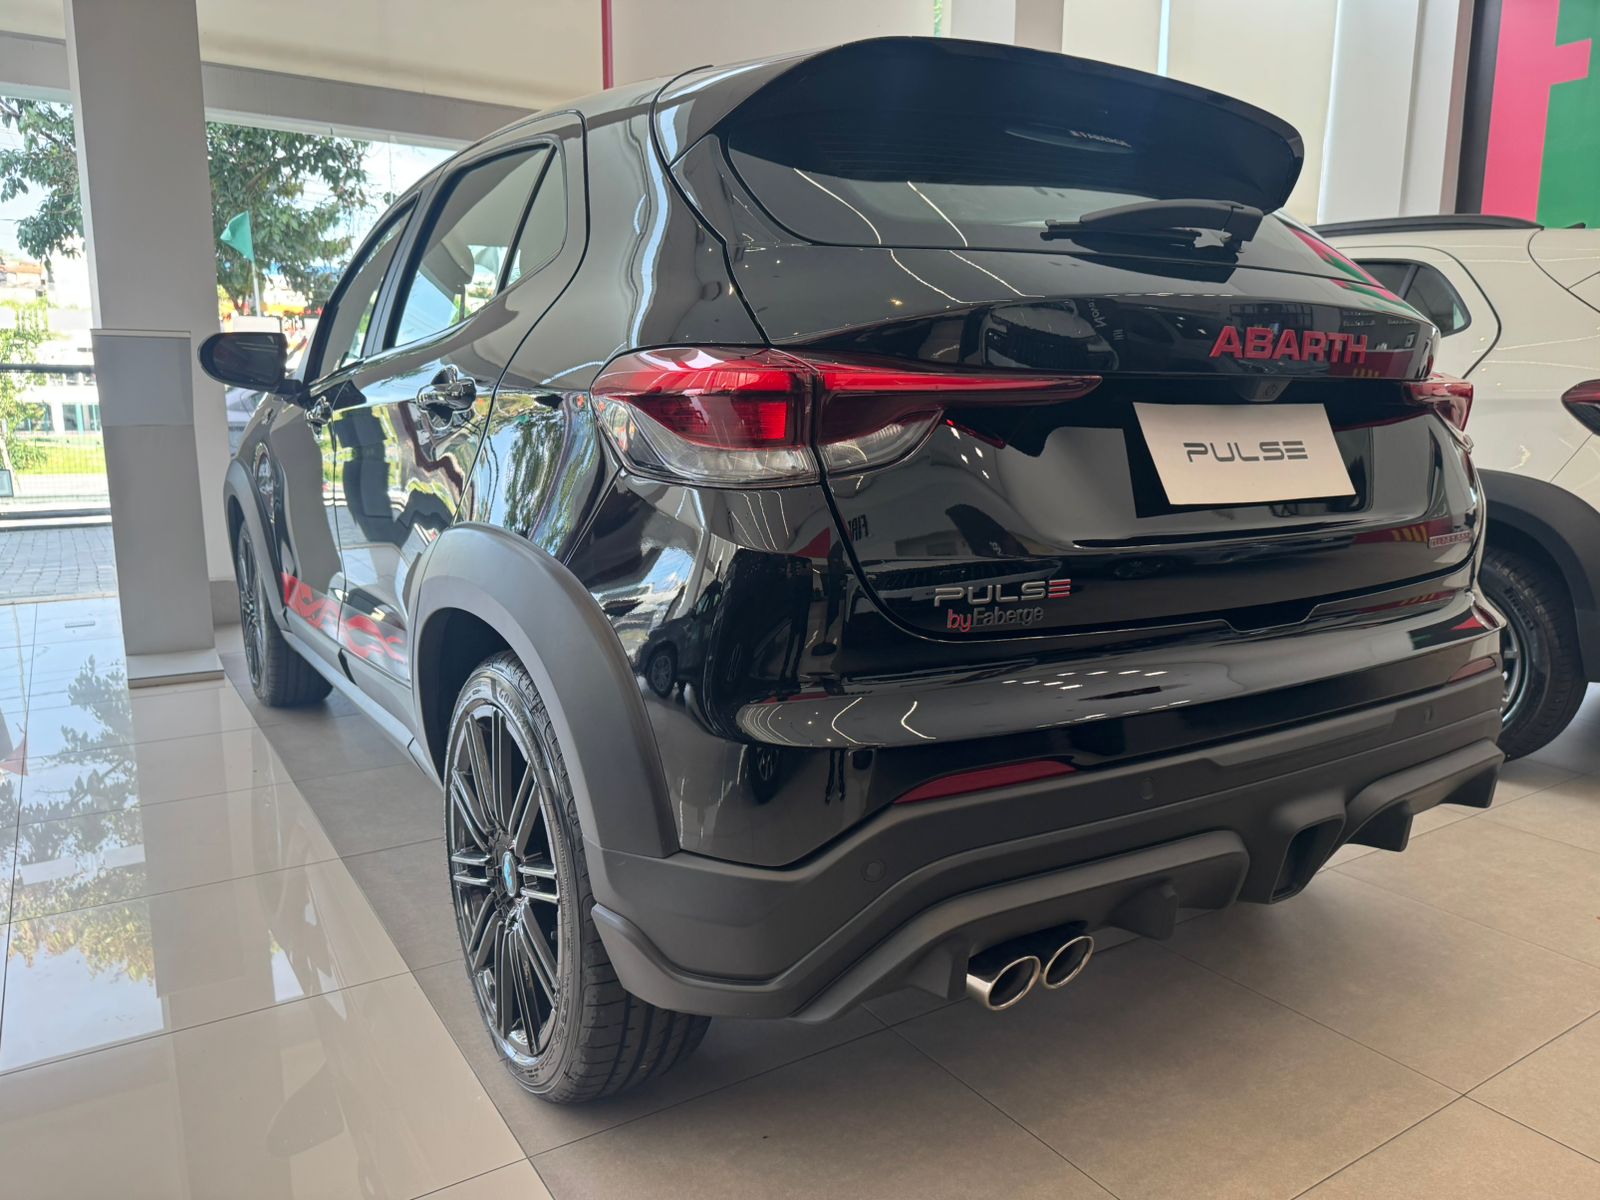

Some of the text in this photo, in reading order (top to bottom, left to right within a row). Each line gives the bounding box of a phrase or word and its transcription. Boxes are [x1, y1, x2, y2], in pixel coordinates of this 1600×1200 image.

[1209, 325, 1368, 364] ABARTH
[1183, 440, 1309, 462] PULSE
[934, 578, 1072, 607] PULSE
